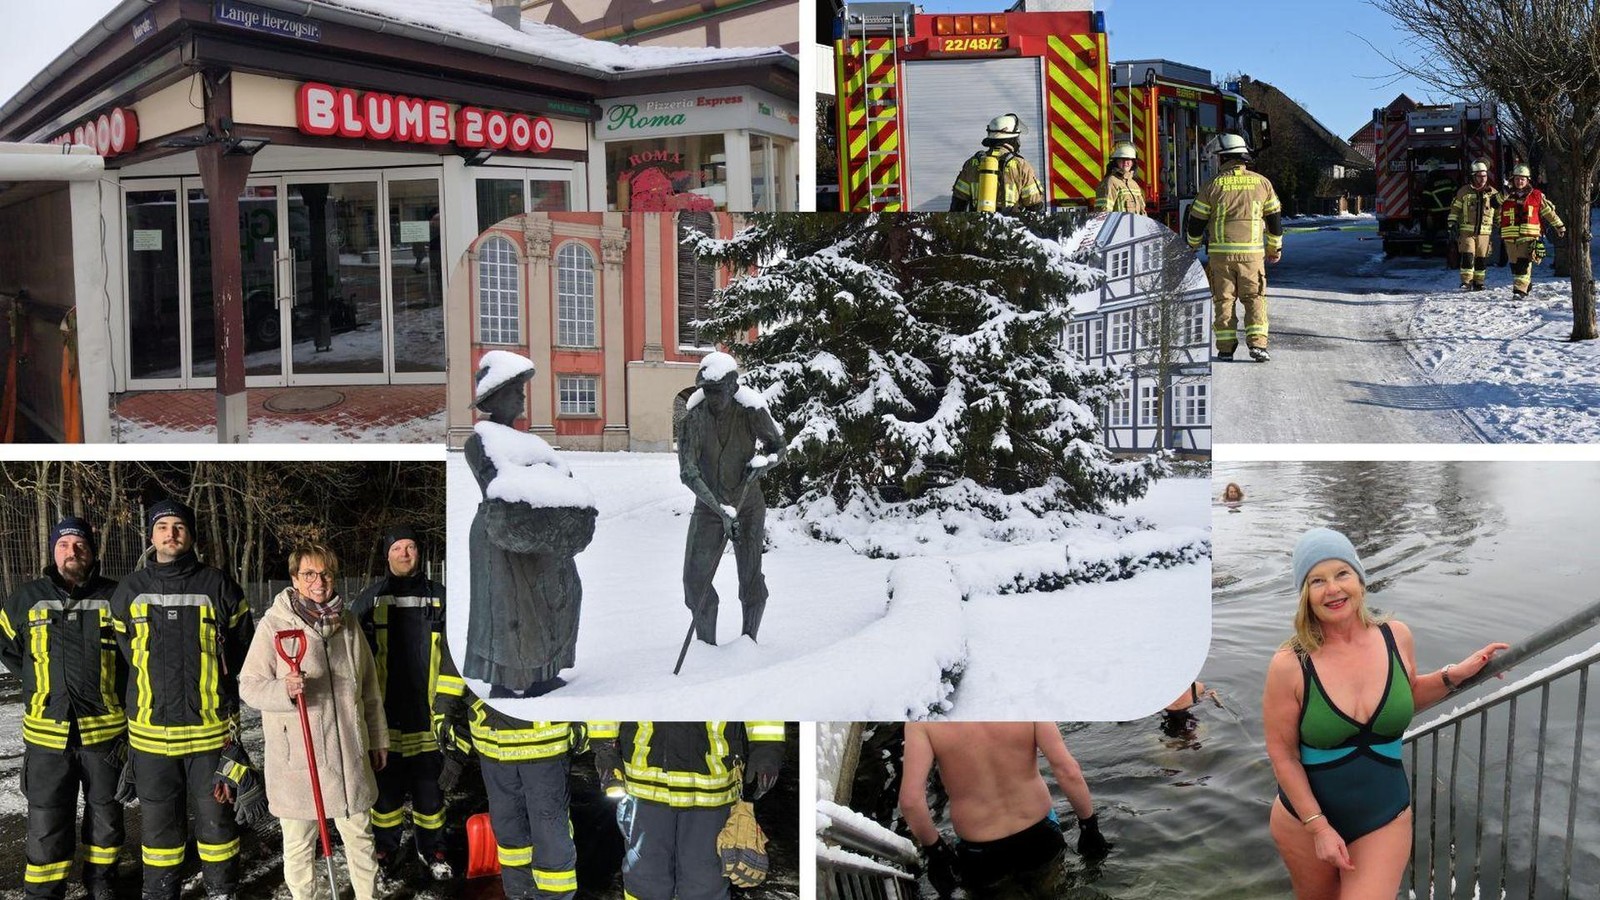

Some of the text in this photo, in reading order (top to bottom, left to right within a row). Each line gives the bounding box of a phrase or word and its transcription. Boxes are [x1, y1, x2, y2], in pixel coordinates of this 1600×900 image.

[221, 4, 320, 37] Lange Herzogstr.
[945, 38, 1003, 51] 22/48/2
[646, 95, 743, 112] Pizzeria Express
[304, 86, 554, 150] BLUME 2000
[606, 104, 687, 131] Roma
[628, 150, 682, 167] ROMA
